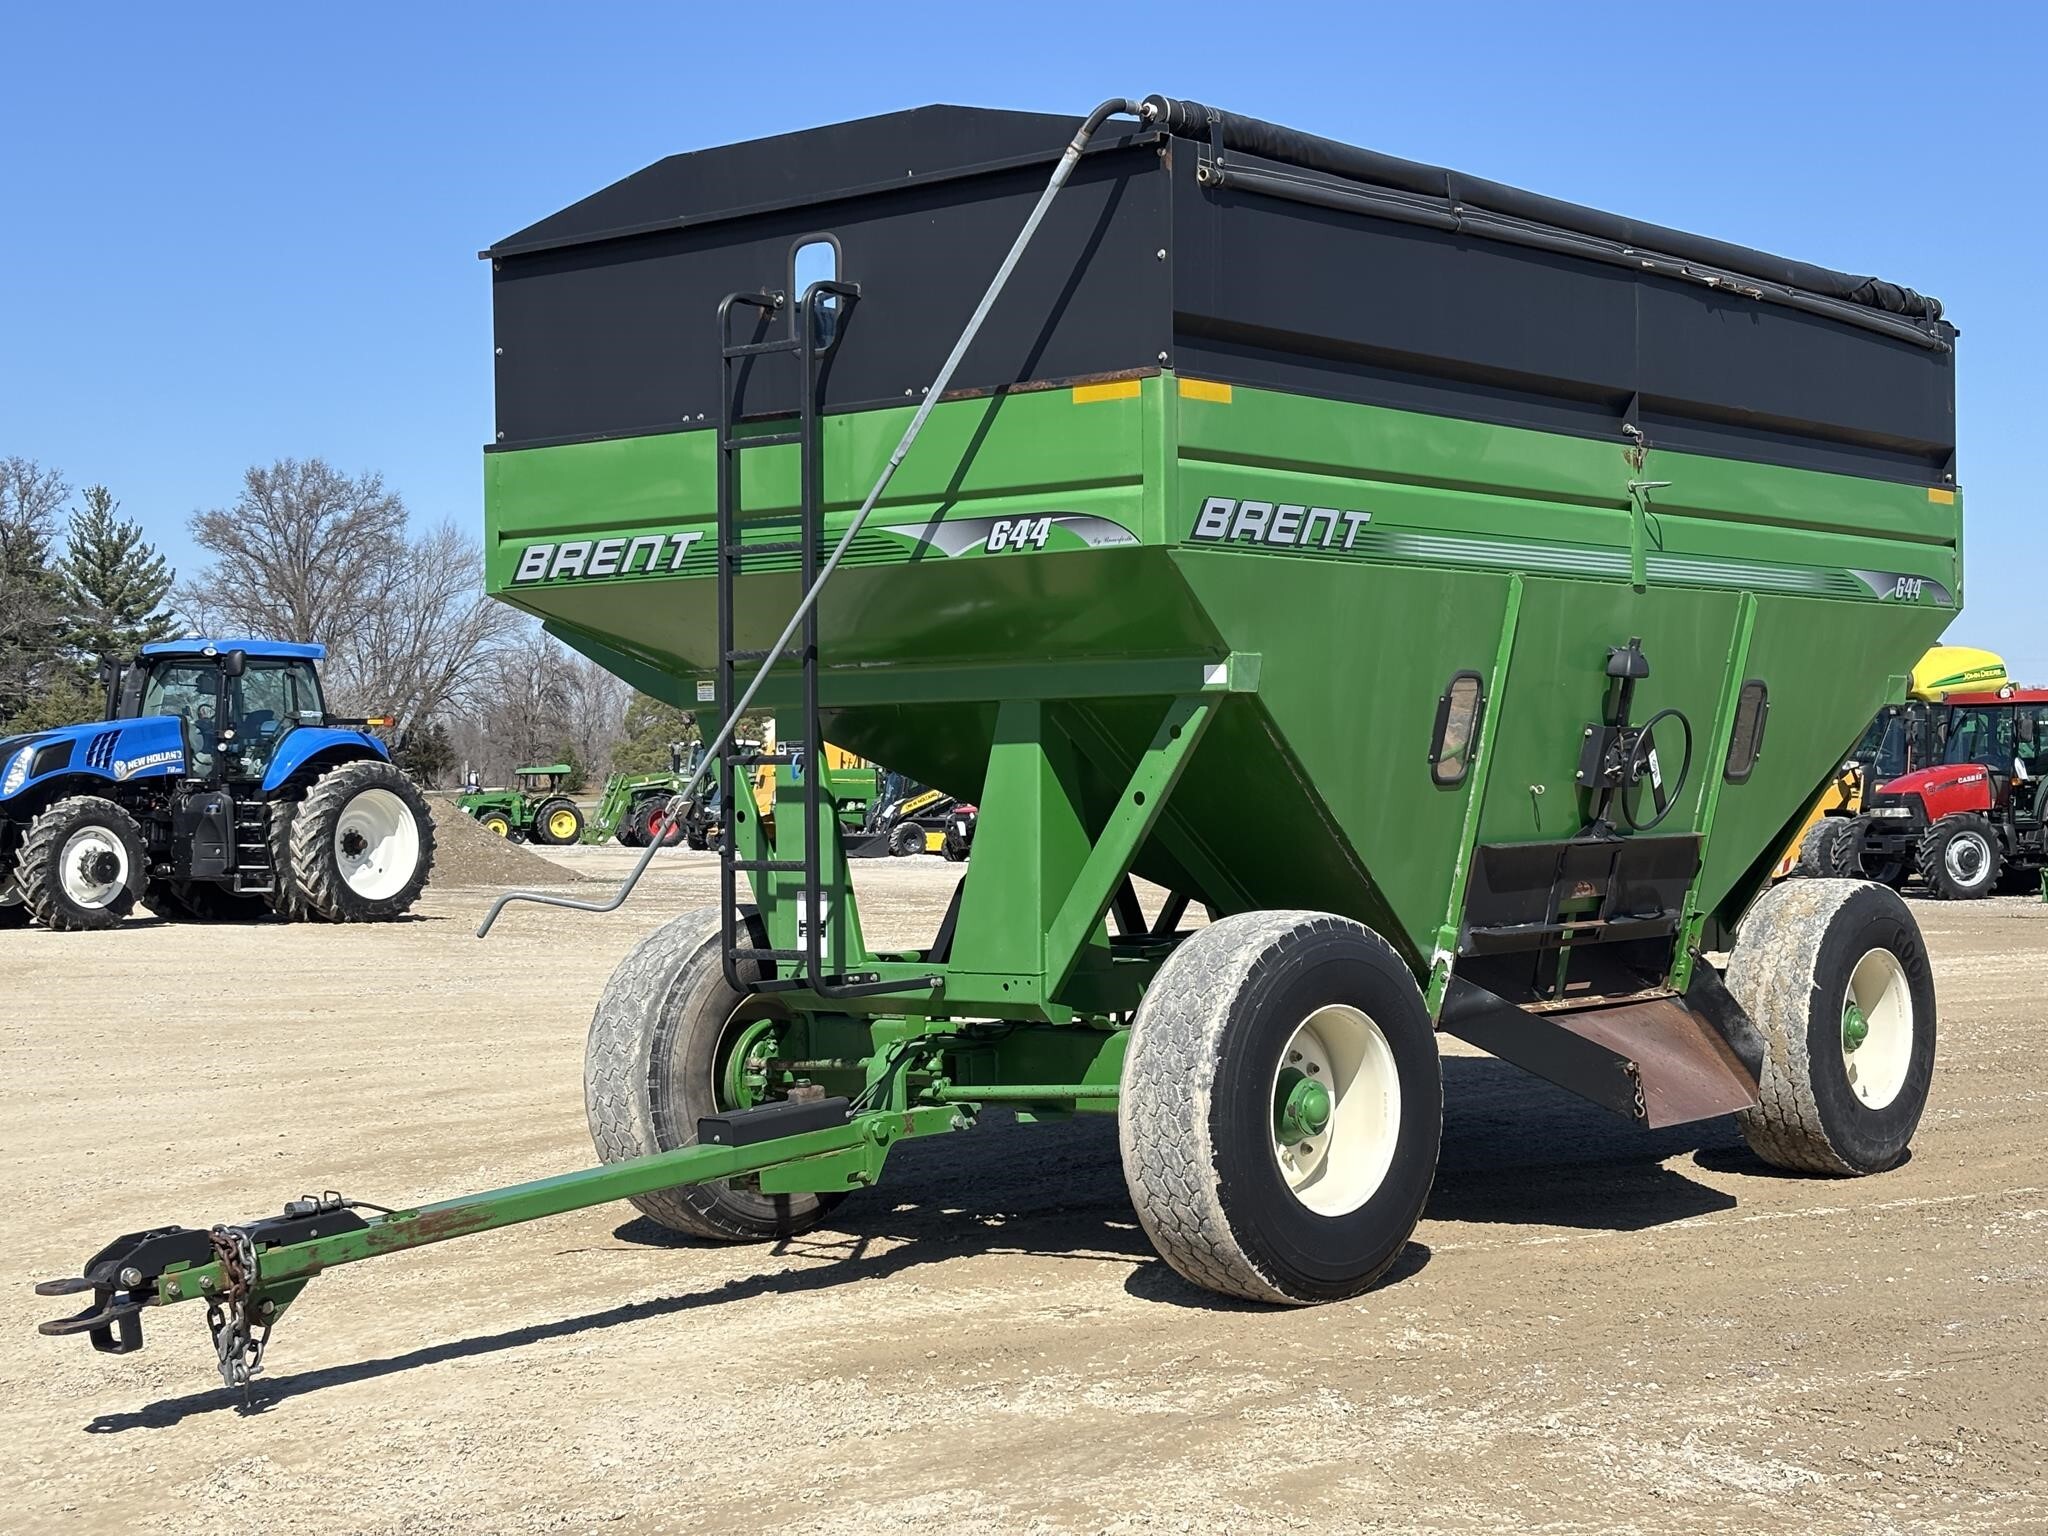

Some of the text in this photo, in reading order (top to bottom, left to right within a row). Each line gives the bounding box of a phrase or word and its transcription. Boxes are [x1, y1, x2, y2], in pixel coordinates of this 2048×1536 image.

[985, 516, 1053, 554] 644
[1190, 496, 1373, 551] BRENT
[511, 530, 705, 584] BRENT
[1894, 577, 1922, 600] 644
[1963, 672, 1981, 681] JOHN
[128, 750, 183, 769] NEW HOLLAND
